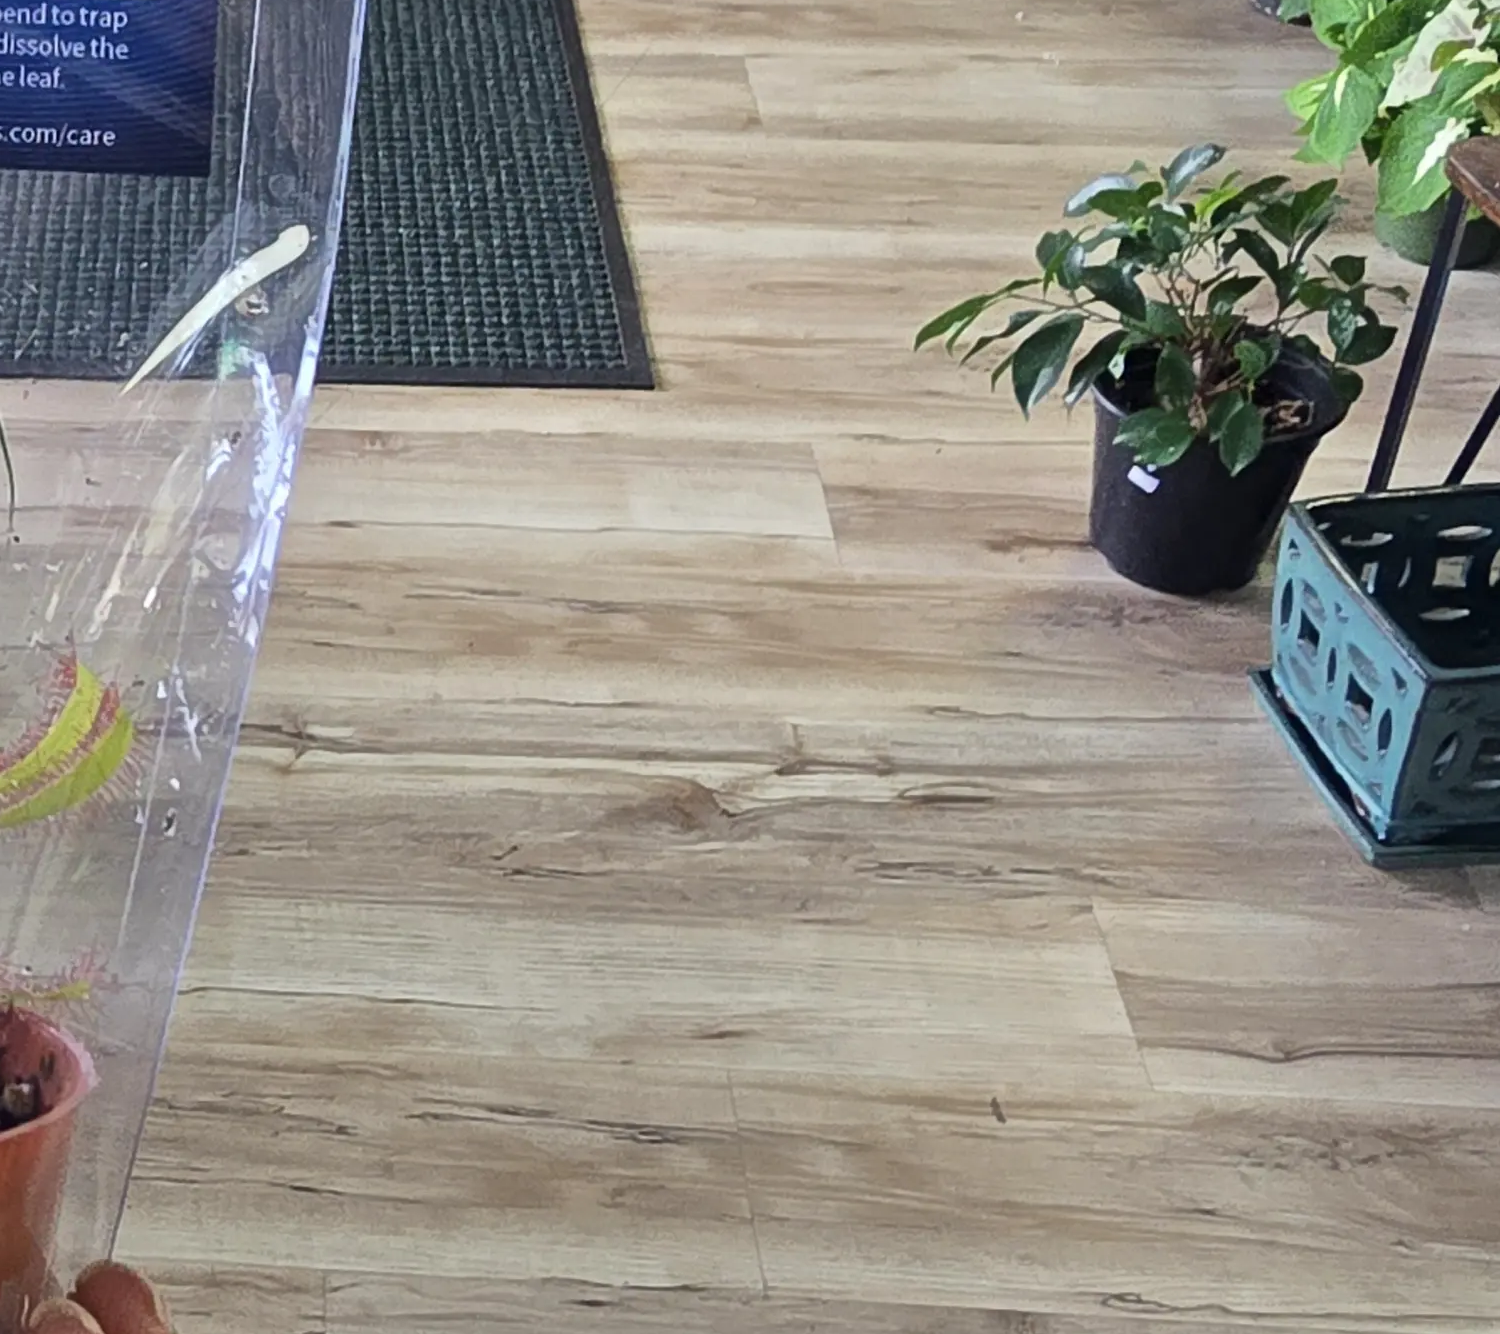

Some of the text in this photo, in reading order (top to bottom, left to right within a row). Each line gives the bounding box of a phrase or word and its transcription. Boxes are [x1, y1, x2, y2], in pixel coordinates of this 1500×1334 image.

[51, 4, 76, 26] to
[79, 6, 129, 34] trap
[90, 36, 130, 60] the
[19, 64, 66, 90] leaf.
